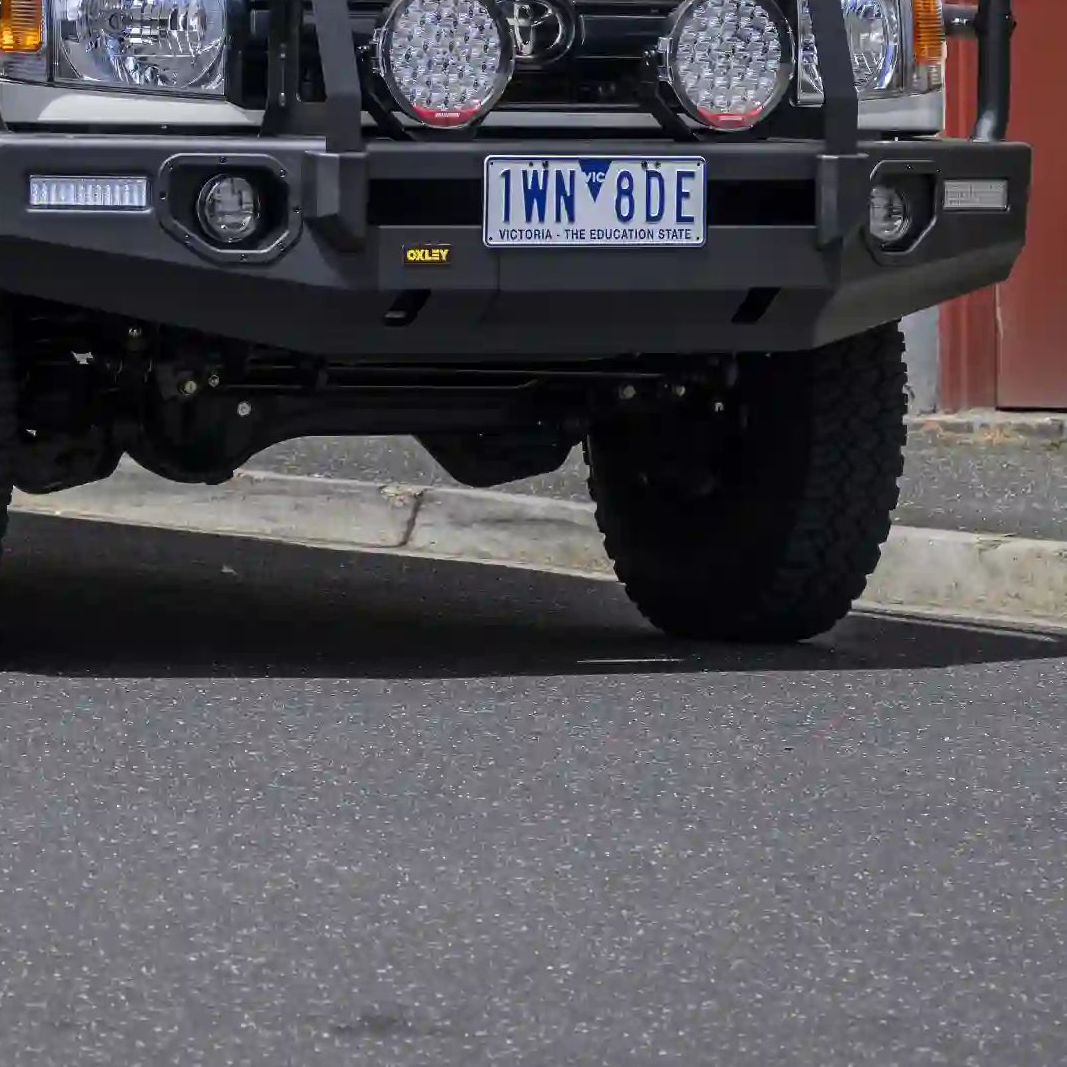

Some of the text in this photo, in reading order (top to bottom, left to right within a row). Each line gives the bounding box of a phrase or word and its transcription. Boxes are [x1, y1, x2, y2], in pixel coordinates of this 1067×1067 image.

[585, 172, 606, 183] VIC
[499, 168, 696, 224] 1WN 8DE
[499, 229, 552, 240] VICTORIA
[565, 229, 586, 240] THE
[590, 229, 654, 240] EDUCATION
[658, 229, 692, 240] STATE
[406, 248, 450, 261] OXLEY
